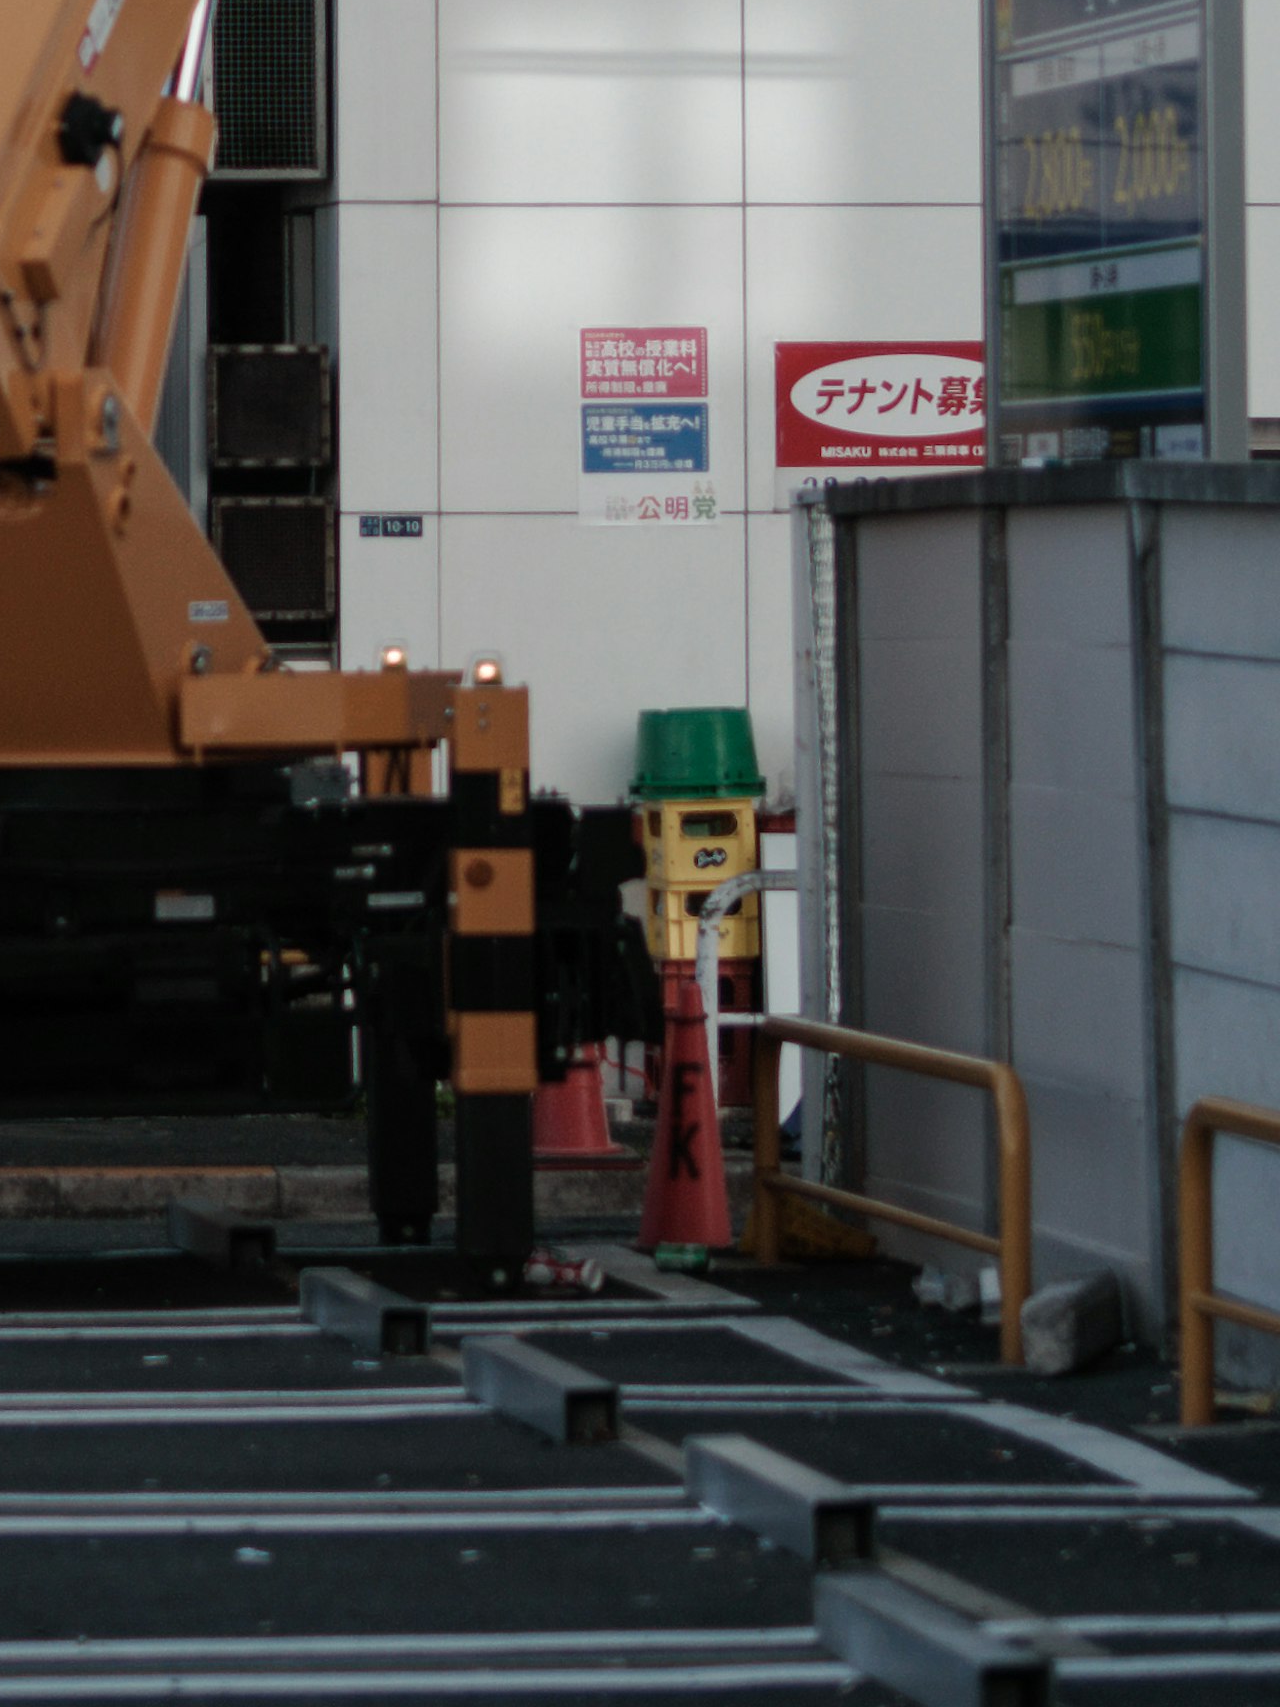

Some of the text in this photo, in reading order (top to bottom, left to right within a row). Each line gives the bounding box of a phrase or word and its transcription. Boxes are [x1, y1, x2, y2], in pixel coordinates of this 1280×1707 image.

[821, 446, 872, 458] MISAKU
[638, 496, 716, 520] 公明党
[386, 520, 419, 533] 10-10
